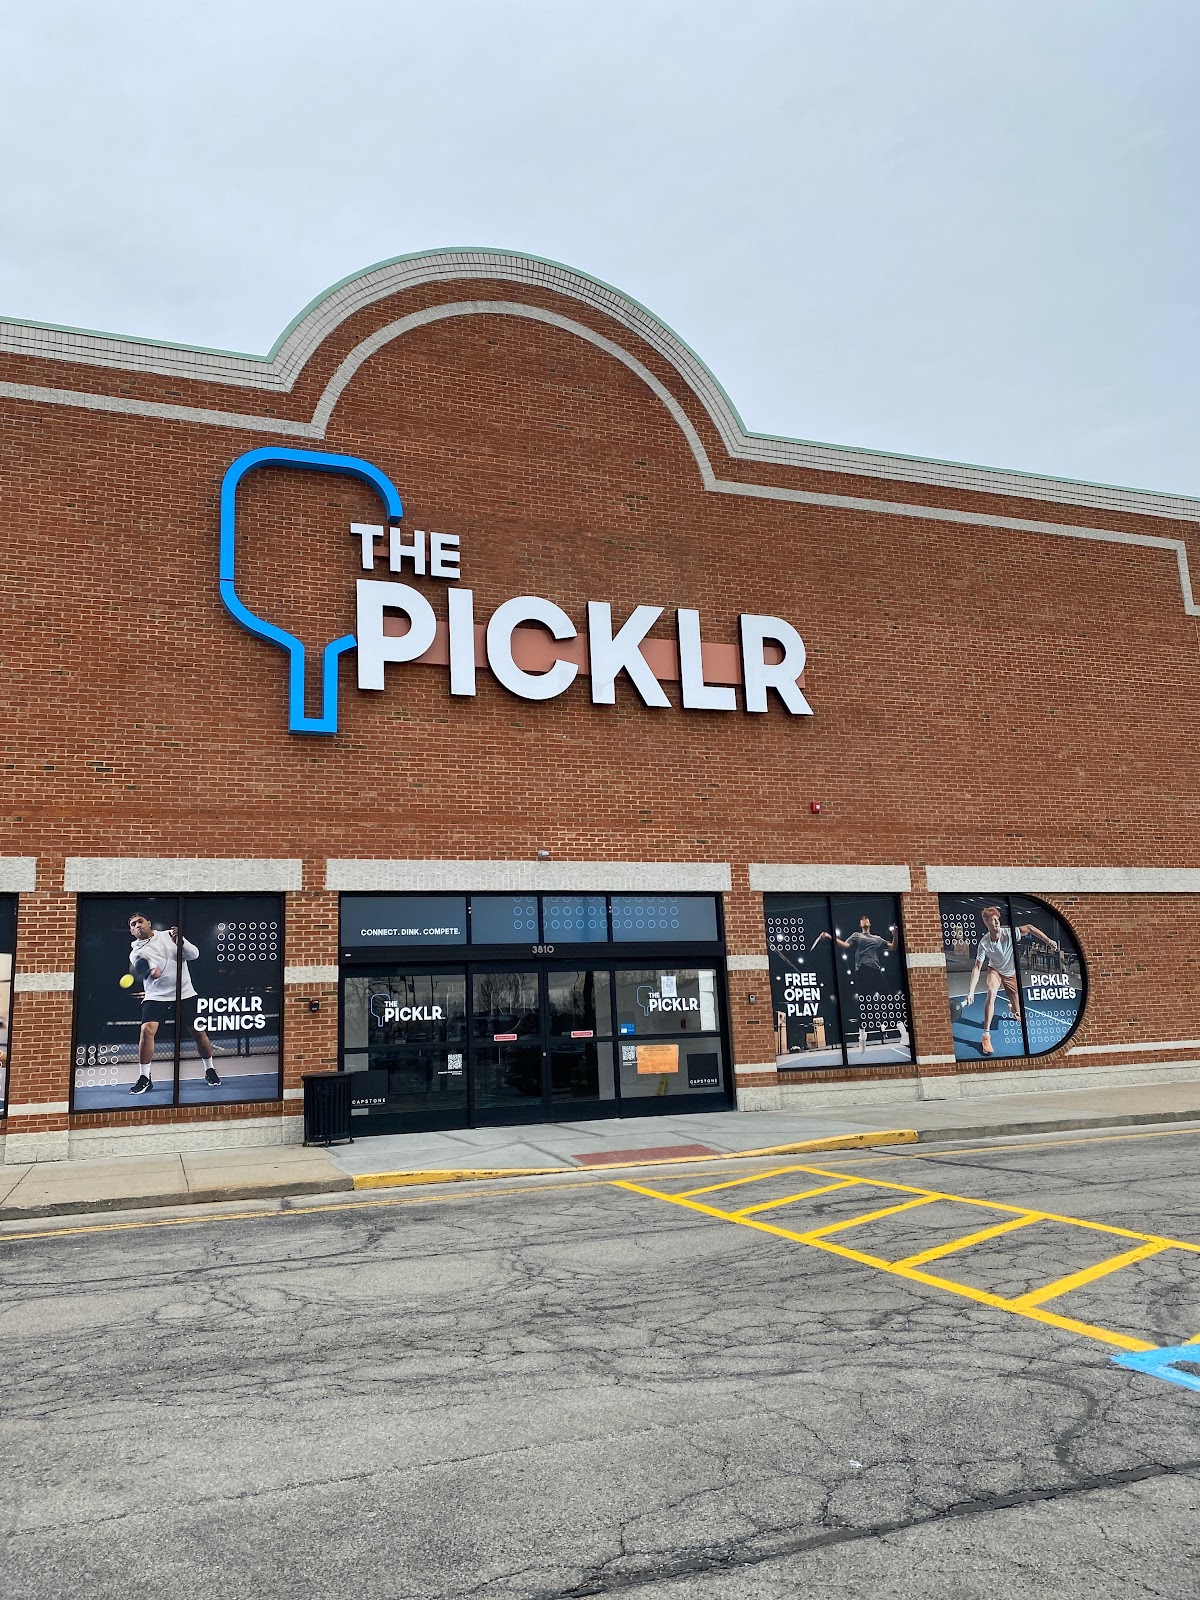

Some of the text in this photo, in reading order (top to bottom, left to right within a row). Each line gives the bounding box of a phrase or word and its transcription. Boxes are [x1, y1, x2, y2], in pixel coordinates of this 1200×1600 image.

[350, 522, 461, 579] THE
[355, 578, 814, 716] PICKLR
[360, 927, 461, 937] CONNECT. DINK. COMPETE.
[532, 945, 555, 954] 3810
[785, 973, 817, 987] FREE
[1030, 973, 1070, 987] PICKLR
[784, 988, 821, 1002] OPEN
[1027, 987, 1077, 1001] LEAGUES
[197, 996, 263, 1014] PICKLR
[649, 998, 698, 1012] PICKLR
[787, 1003, 819, 1017] PLAY
[384, 1005, 443, 1022] PICKLR
[193, 1014, 266, 1032] CLINICS
[351, 1097, 386, 1105] CAPSTONE
